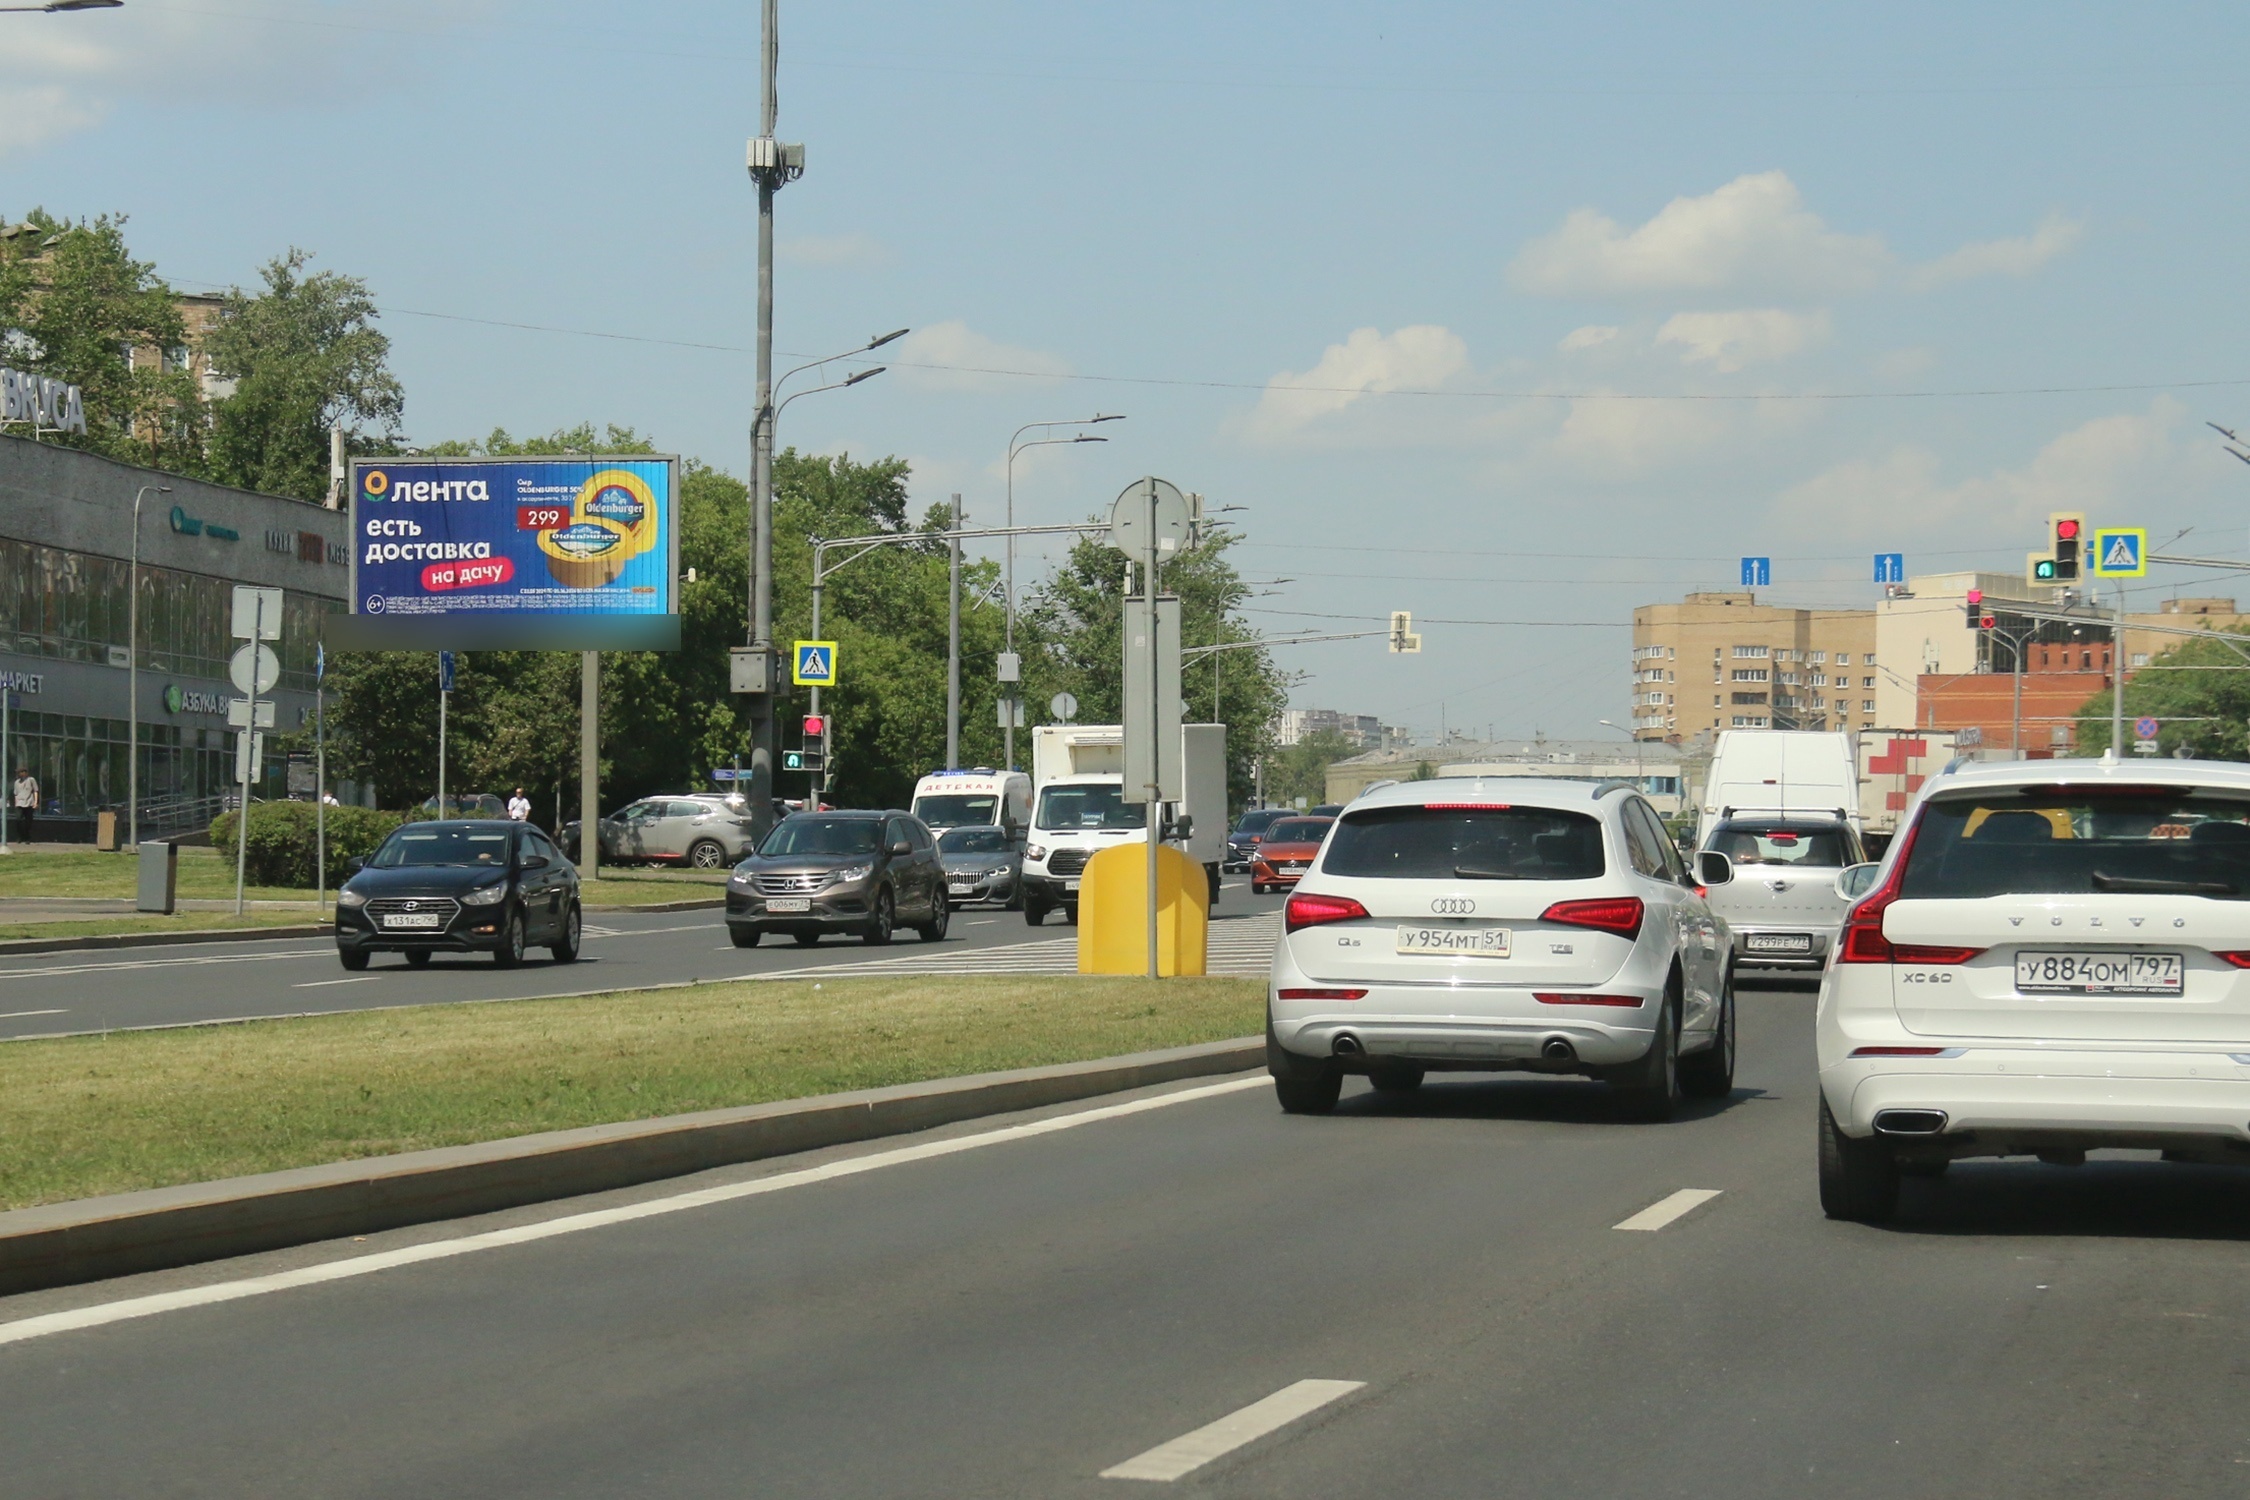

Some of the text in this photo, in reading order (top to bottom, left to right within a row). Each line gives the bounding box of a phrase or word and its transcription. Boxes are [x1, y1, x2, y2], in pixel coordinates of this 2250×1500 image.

[0, 367, 87, 435] ВКУСА
[391, 480, 489, 502] лента
[517, 486, 569, 494] OLDENBURGER
[586, 503, 644, 515] Oldenburger
[528, 511, 559, 525] 299
[366, 519, 422, 536] есть
[551, 532, 620, 541] Oldenburger
[365, 540, 491, 564] доставка
[432, 563, 504, 585] на дачу
[181, 691, 218, 714] АЗБУКА
[924, 783, 994, 792] ДЕТСКАЯ
[2008, 916, 2186, 929] VOLVO
[1406, 930, 1504, 949] У954МТ 51
[2026, 957, 2174, 982] У884ОМ 797
[2142, 976, 2163, 984] RUS
